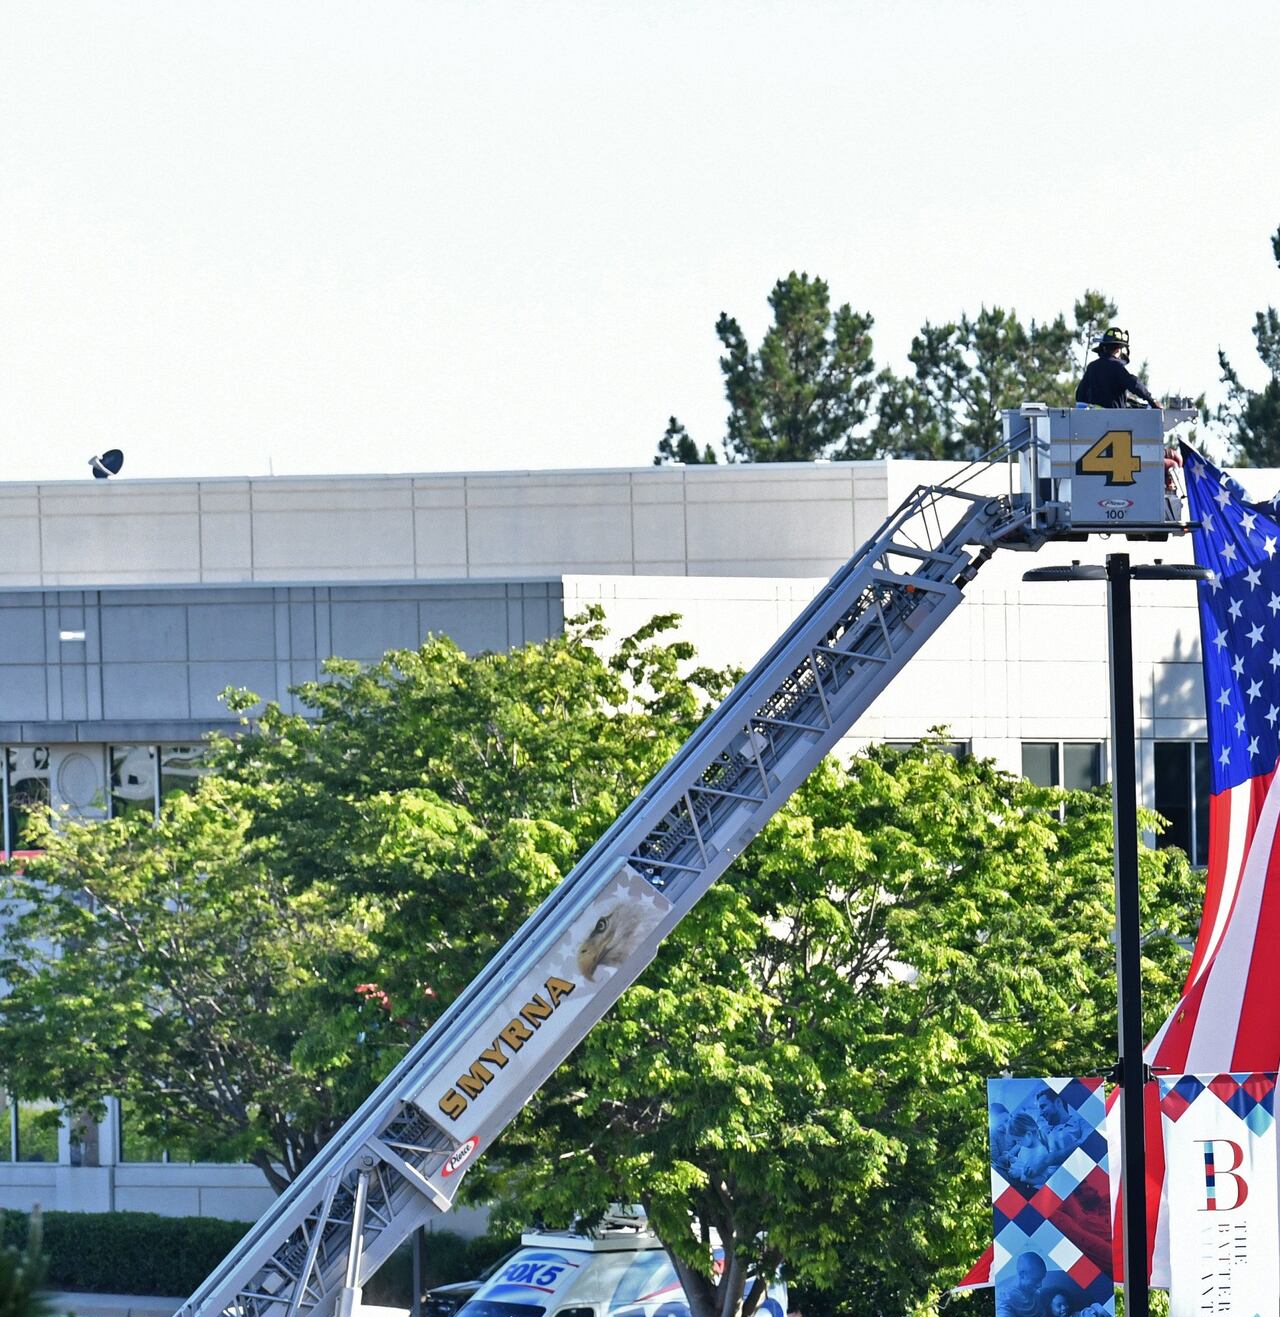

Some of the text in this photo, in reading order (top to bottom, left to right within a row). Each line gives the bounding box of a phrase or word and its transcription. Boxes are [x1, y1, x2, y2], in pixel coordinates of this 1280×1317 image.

[1076, 430, 1141, 486] 4
[1105, 510, 1127, 519] 100'
[438, 976, 576, 1121] SMYRNA
[450, 1144, 471, 1170] Pierce
[1193, 1139, 1249, 1212] B
[1234, 1220, 1248, 1265] THE
[495, 1263, 565, 1286] FOX 5
